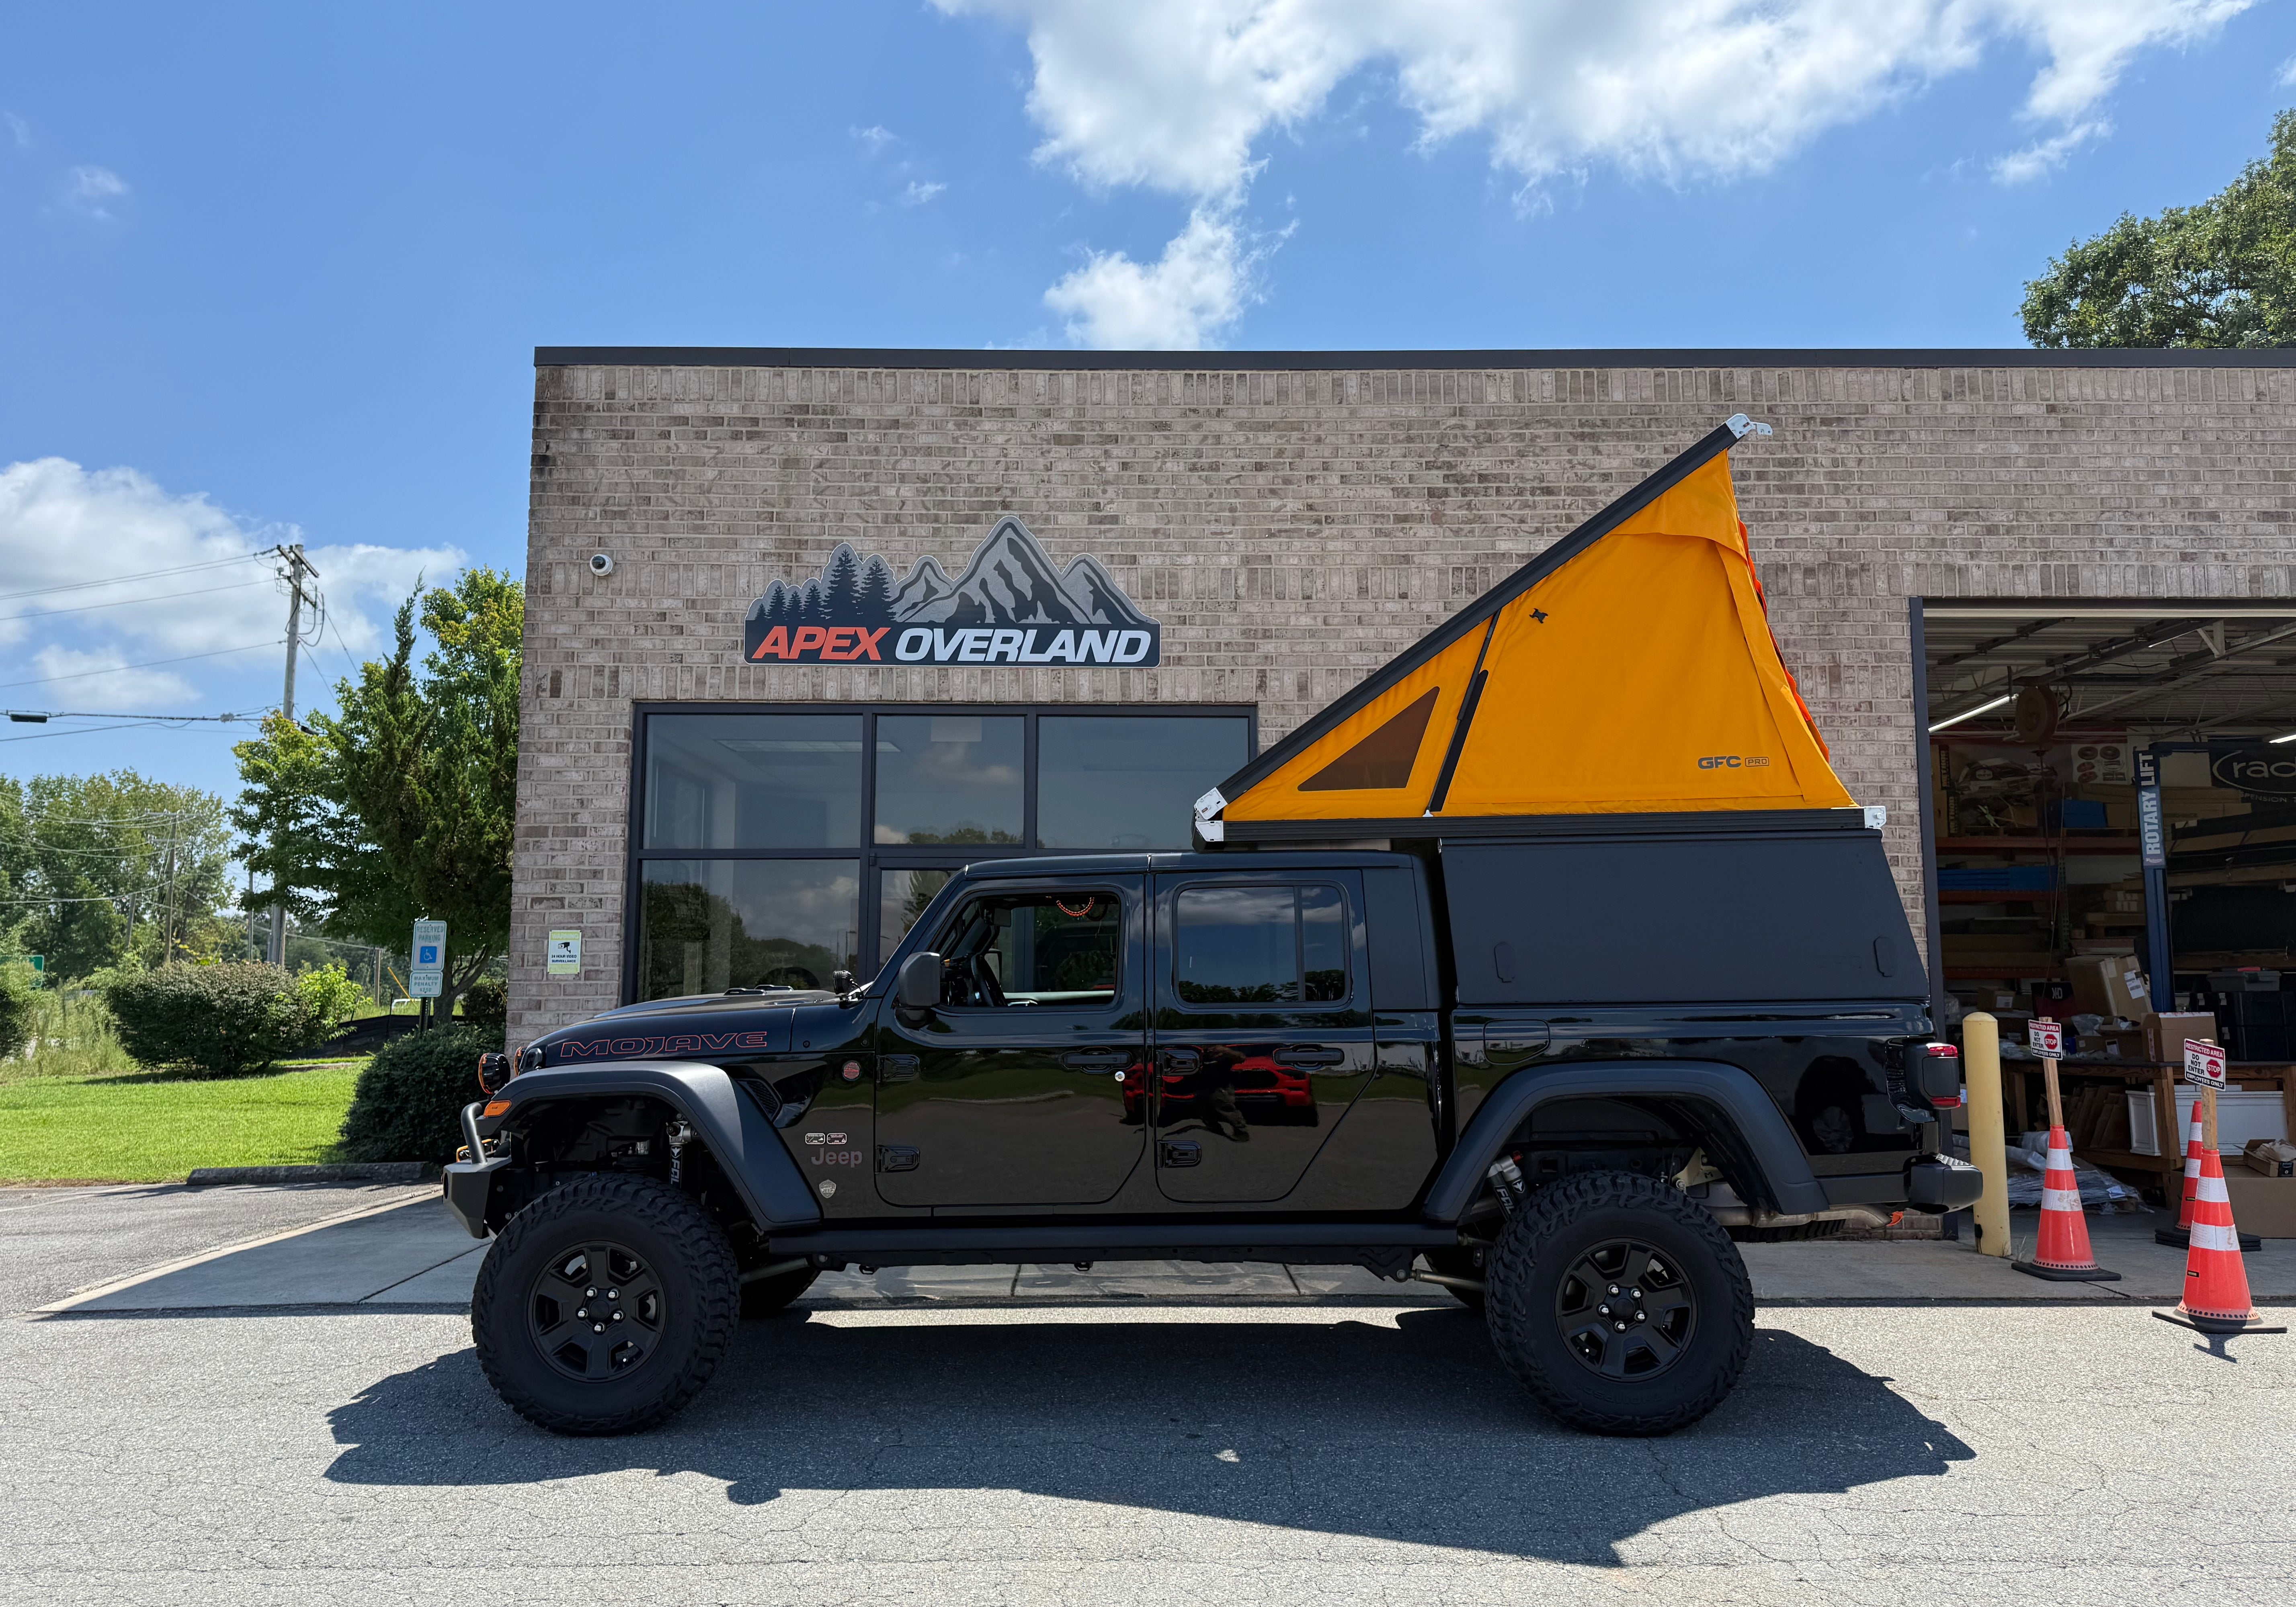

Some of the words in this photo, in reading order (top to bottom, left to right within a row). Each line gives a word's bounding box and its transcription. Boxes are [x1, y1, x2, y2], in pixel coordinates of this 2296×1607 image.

[752, 626, 891, 660] APEX
[895, 628, 1151, 663] OVERLAND
[1698, 756, 1741, 769] GFC
[2139, 753, 2155, 786] LIFT
[2142, 791, 2161, 855] ROTARY
[561, 1031, 767, 1057] MOJAVE
[2186, 1043, 2210, 1054] RESTRICTED
[2188, 1065, 2204, 1075] ENTER
[2207, 1064, 2220, 1073] STOP
[811, 1148, 863, 1168] Jeep
